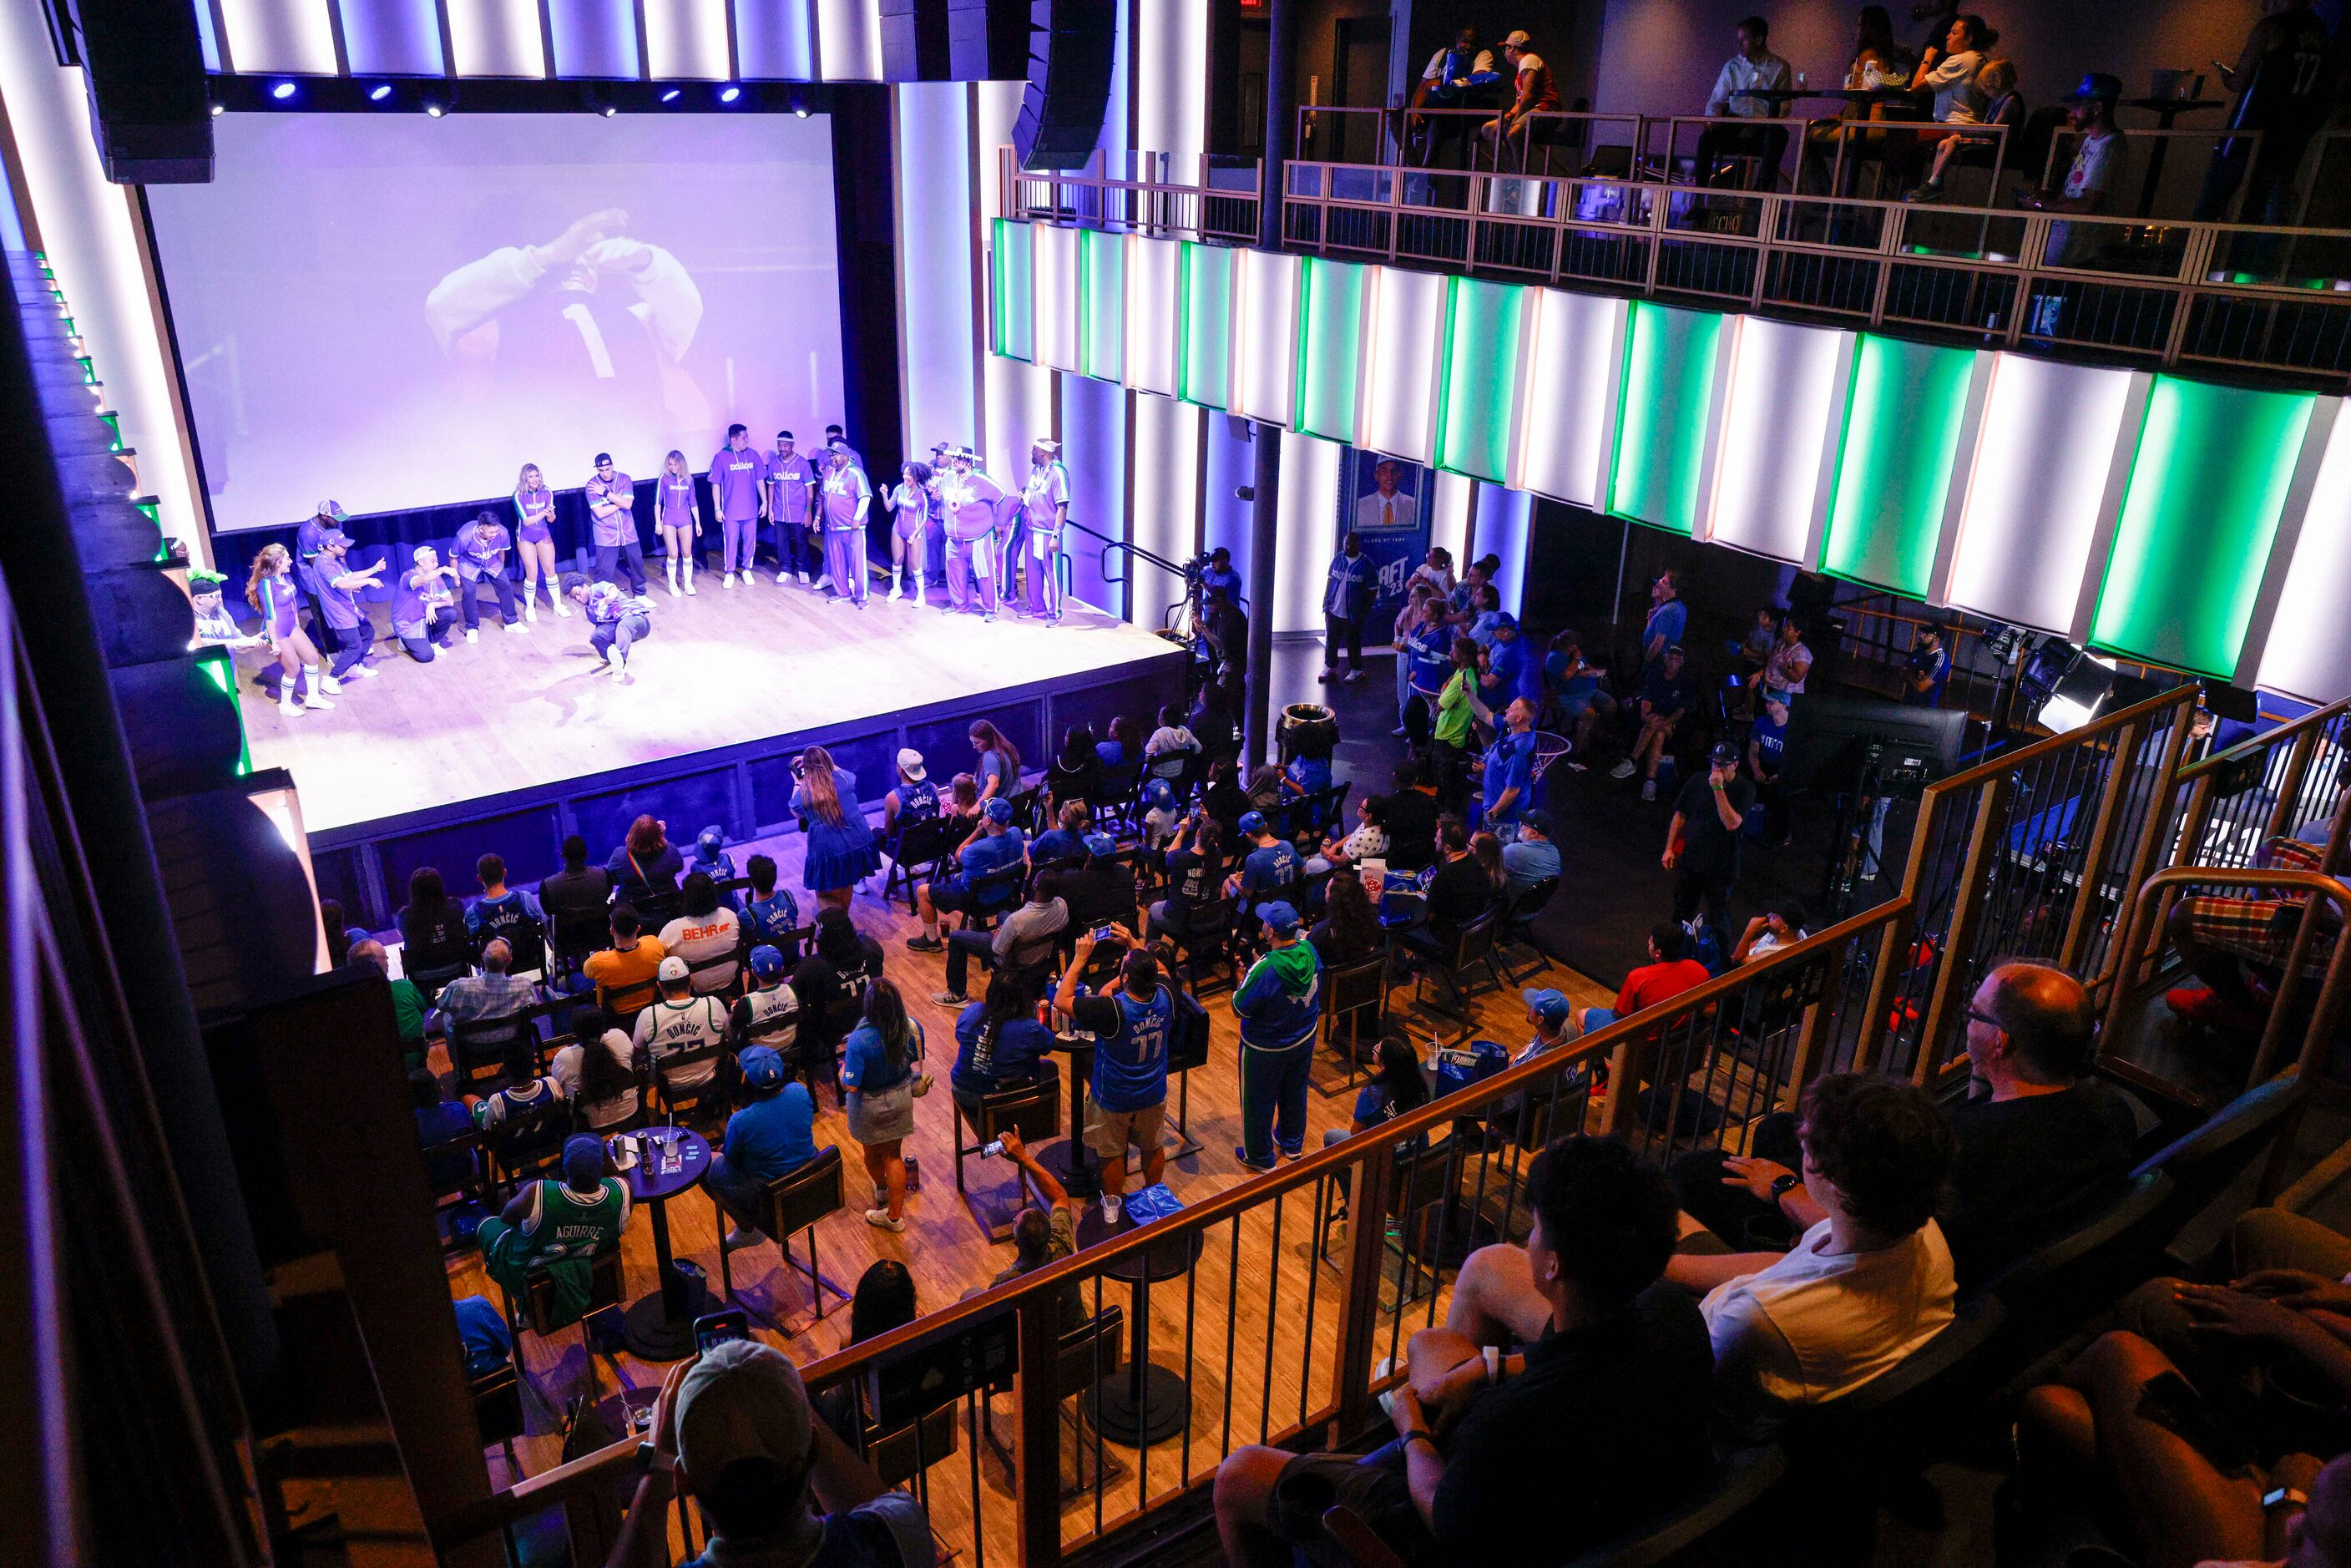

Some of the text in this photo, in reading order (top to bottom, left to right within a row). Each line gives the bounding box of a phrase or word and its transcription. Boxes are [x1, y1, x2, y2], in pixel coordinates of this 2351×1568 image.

[1378, 555, 1408, 585] AFT
[682, 924, 718, 941] BEHR
[666, 1021, 701, 1039] DONČIĆ
[1133, 1014, 1166, 1034] DONČIĆ
[1130, 1029, 1163, 1064] 77
[555, 1225, 604, 1240] AGUIRRE
